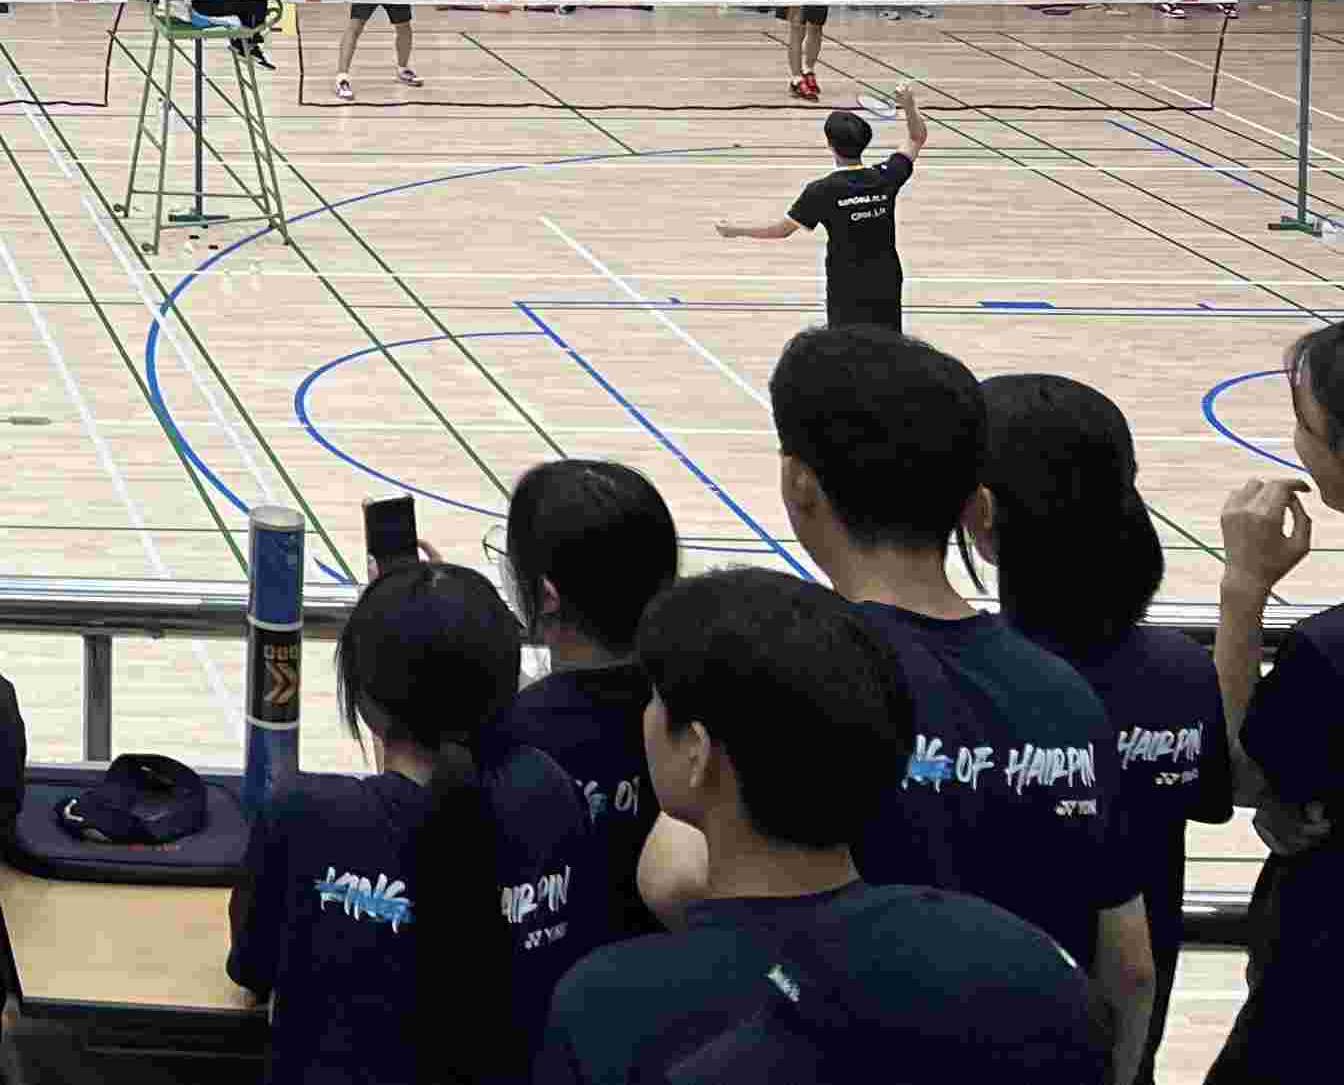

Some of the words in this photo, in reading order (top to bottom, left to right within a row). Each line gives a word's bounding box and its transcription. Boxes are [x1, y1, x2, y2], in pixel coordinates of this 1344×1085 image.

[955, 745, 996, 792] OF
[1004, 741, 1097, 796] HAIRPIN
[1116, 719, 1204, 771] HAIRPIN
[313, 865, 416, 934] KING
